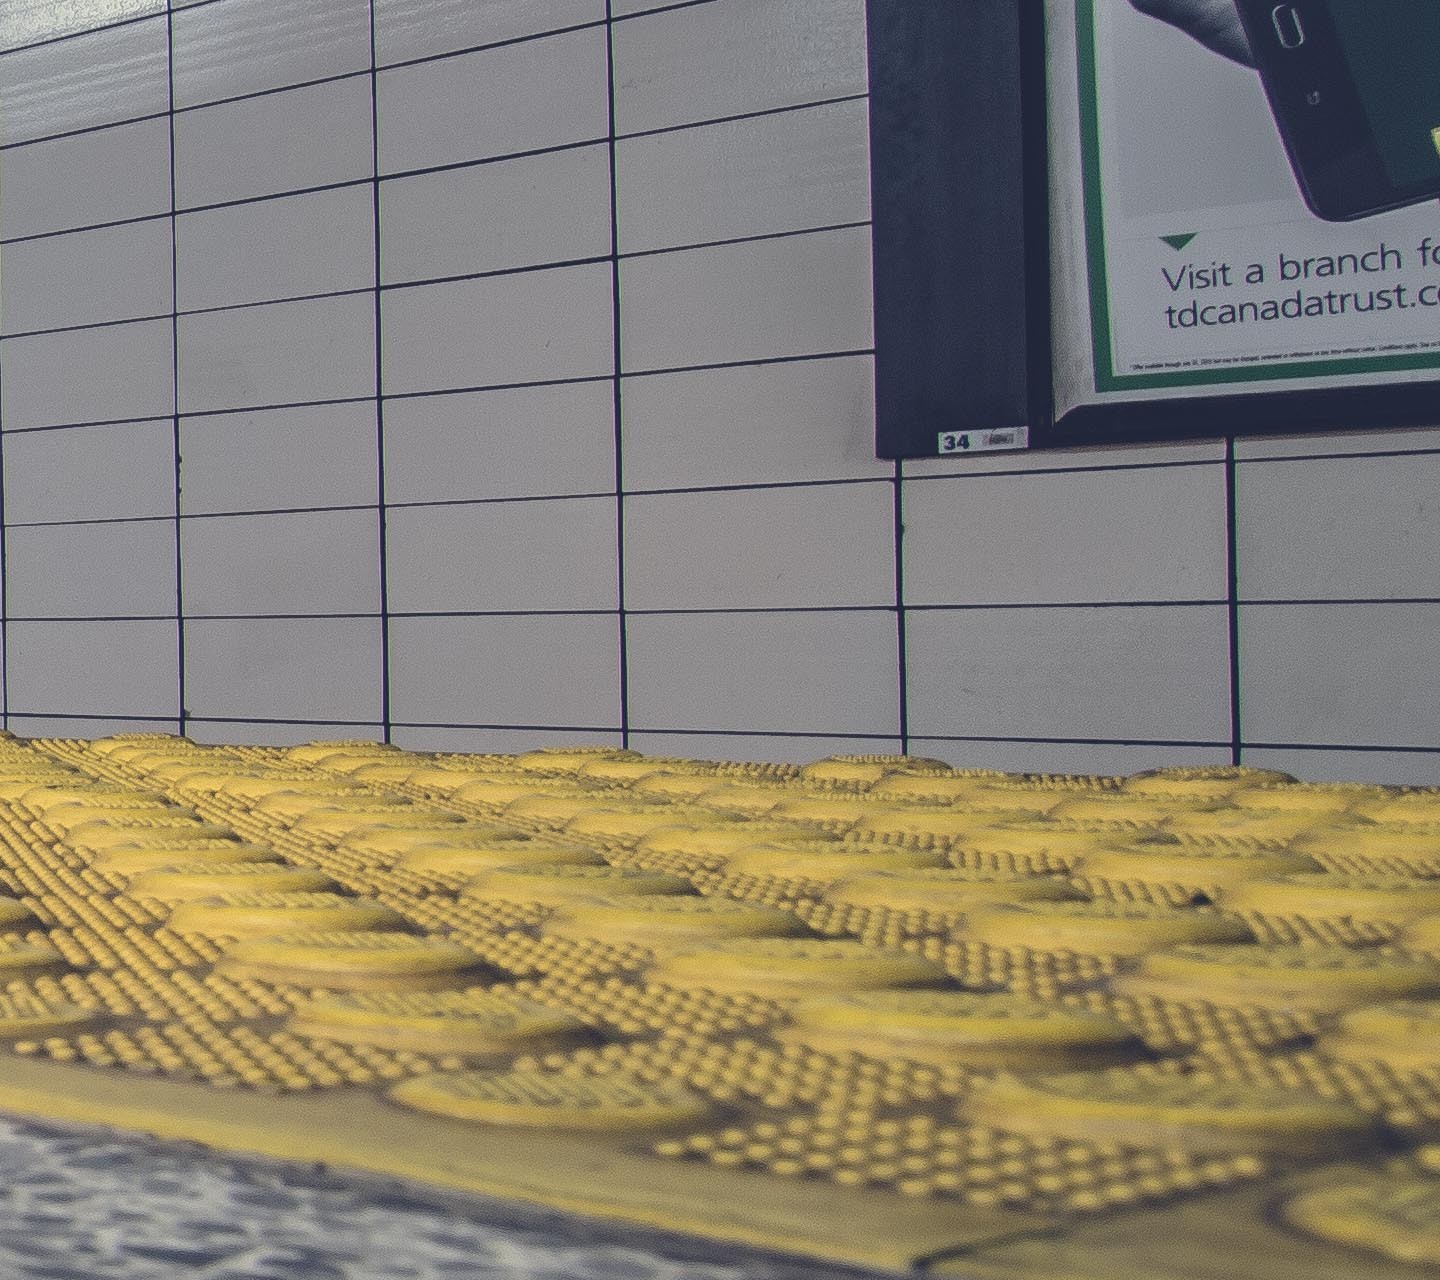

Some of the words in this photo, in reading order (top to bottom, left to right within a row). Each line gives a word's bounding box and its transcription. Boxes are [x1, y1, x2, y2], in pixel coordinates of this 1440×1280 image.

[1161, 261, 1232, 291] Visit
[1245, 263, 1264, 284] a
[1279, 243, 1402, 280] branch
[1165, 283, 1440, 329] tdcanadatrust.c
[943, 434, 970, 451] 34
